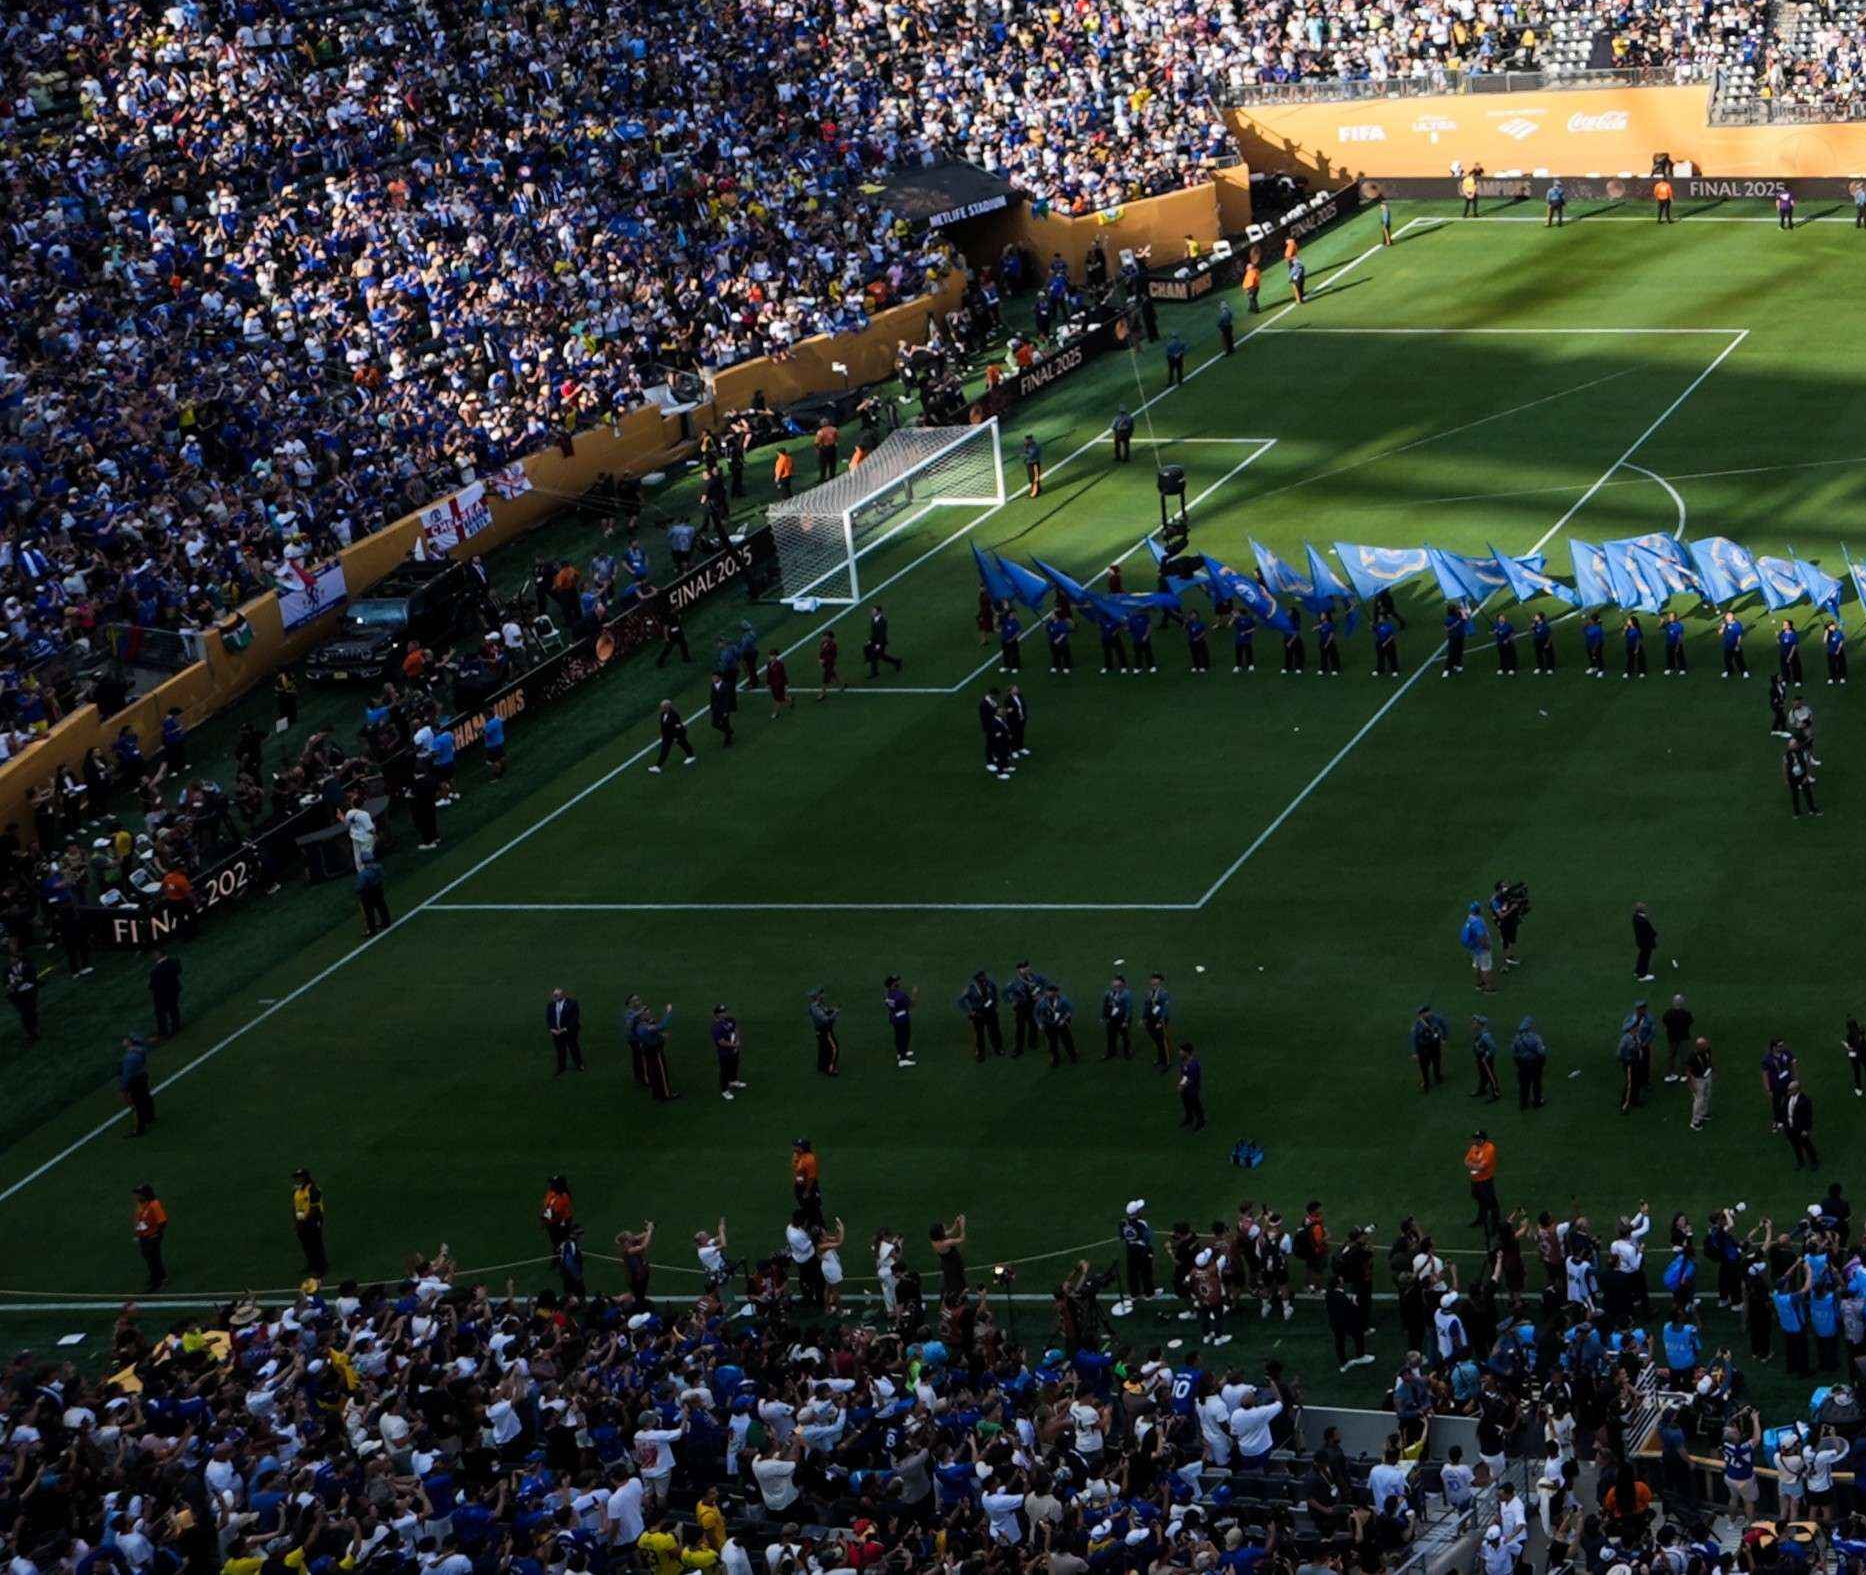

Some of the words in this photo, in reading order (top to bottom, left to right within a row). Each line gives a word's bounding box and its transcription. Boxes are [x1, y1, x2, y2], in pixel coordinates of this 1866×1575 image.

[1338, 125, 1387, 143] FIFA
[1689, 181, 1741, 197] FINAL
[1744, 181, 1785, 197] 2025
[929, 205, 968, 227] METLIFE
[970, 194, 1007, 214] STADIUM
[1020, 363, 1056, 396] FINAL
[1054, 347, 1082, 375] 2025
